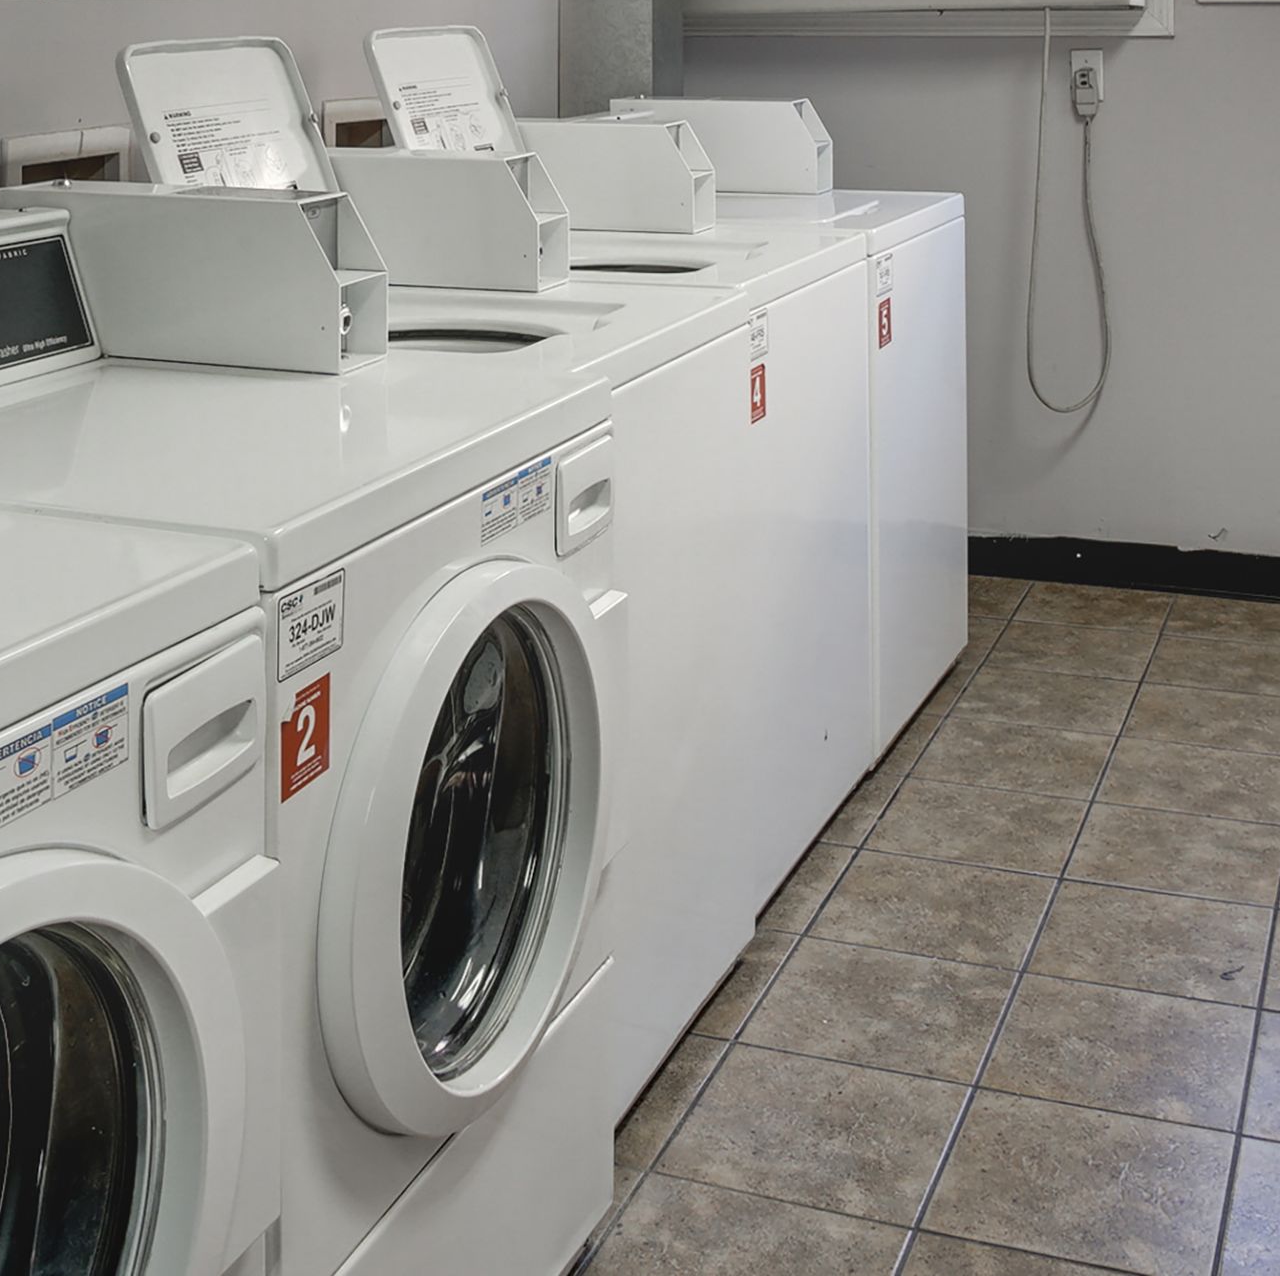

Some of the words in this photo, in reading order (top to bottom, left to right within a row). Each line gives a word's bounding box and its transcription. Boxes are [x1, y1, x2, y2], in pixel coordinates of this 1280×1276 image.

[881, 308, 890, 336] 5
[752, 376, 762, 408] 4
[288, 602, 336, 644] 324-DJW
[75, 694, 106, 718] NOTICE
[295, 704, 318, 767] 2
